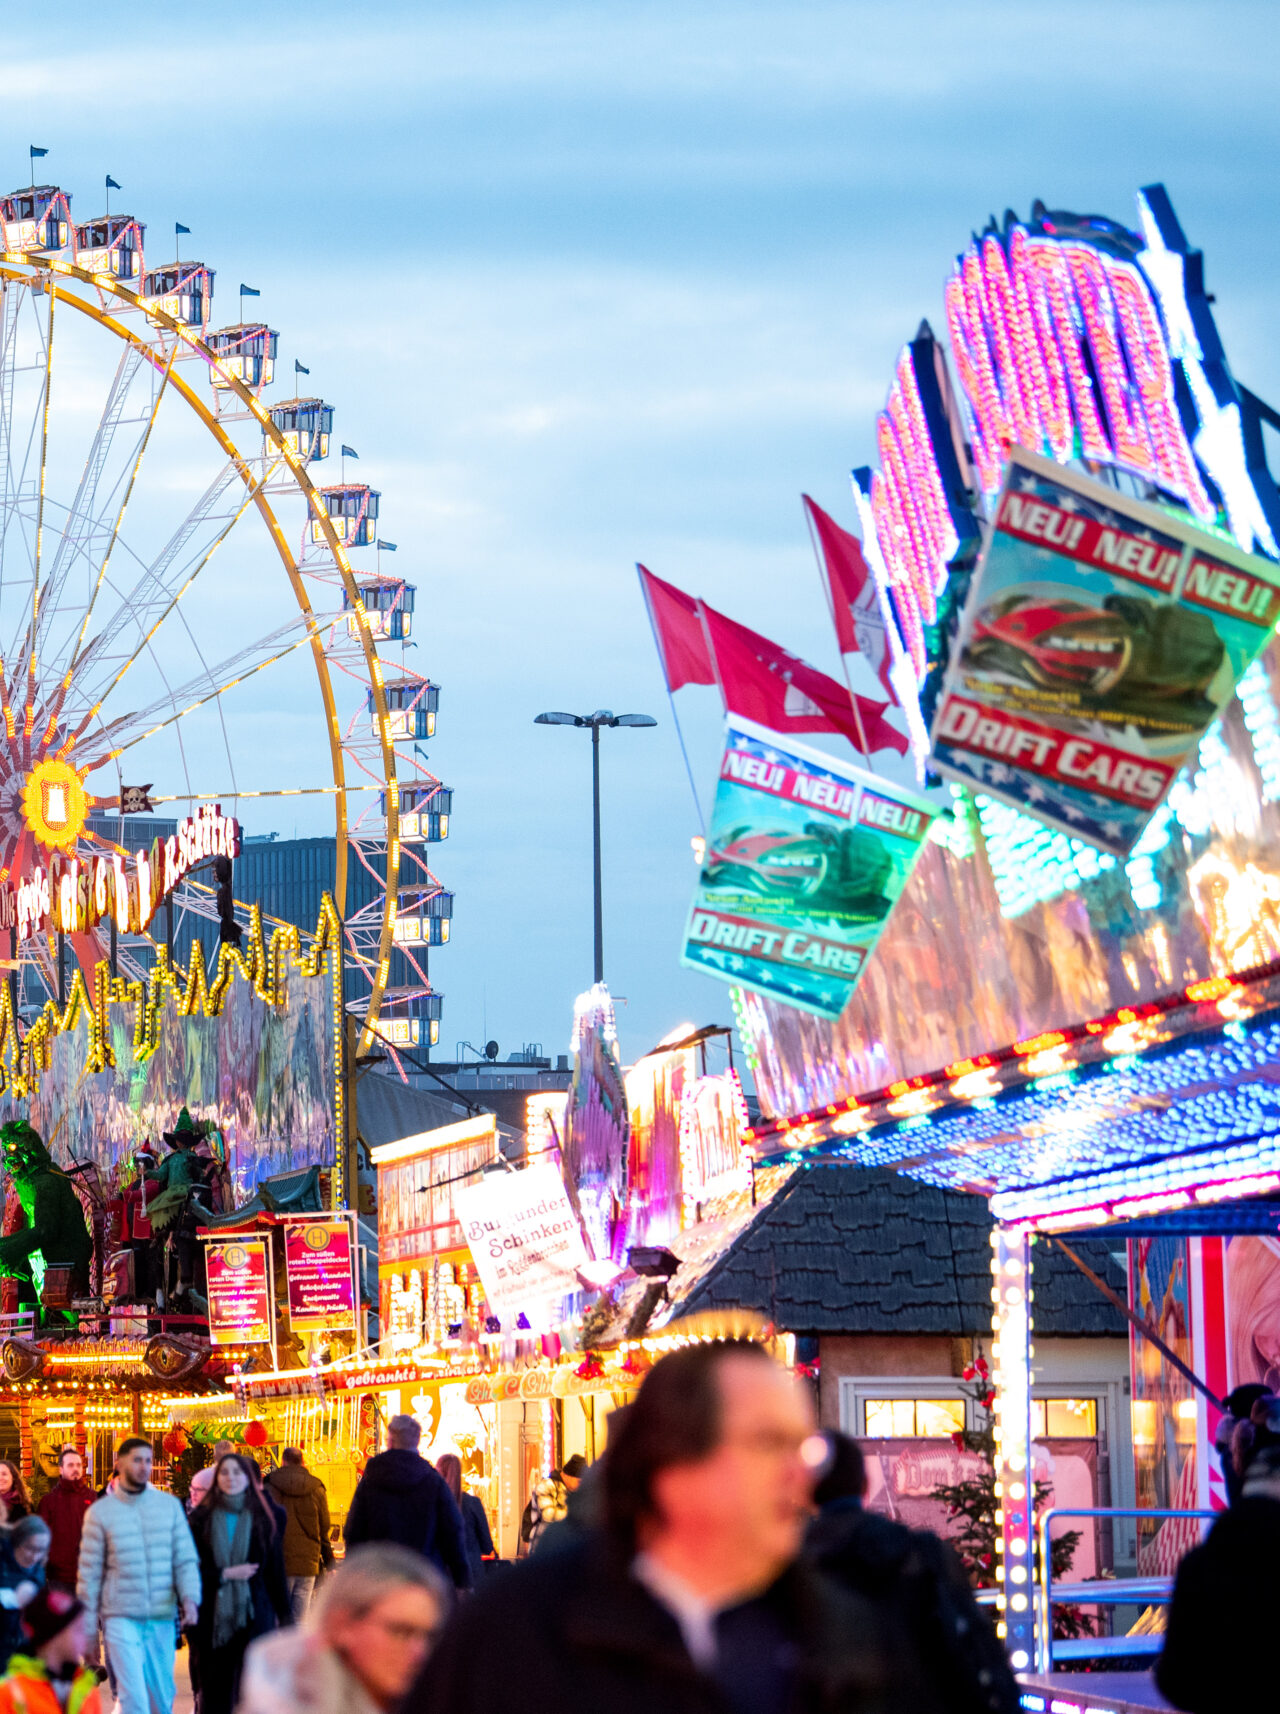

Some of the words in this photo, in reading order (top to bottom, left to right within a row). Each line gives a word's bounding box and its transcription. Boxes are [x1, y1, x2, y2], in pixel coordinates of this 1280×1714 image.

[1002, 494, 1086, 550] NEU!
[1093, 530, 1181, 584] NEU!
[1186, 562, 1274, 618] NEU!
[939, 702, 1057, 766] DRIFT
[1057, 740, 1165, 800] CARS
[723, 751, 786, 792] NEU!
[792, 775, 853, 814] NEU!
[860, 797, 921, 836] NEU!
[690, 911, 781, 956] DRIFT
[781, 932, 862, 975] CARS
[307, 1256, 349, 1266] Doppeldecker
[488, 1219, 574, 1258] Schinken
